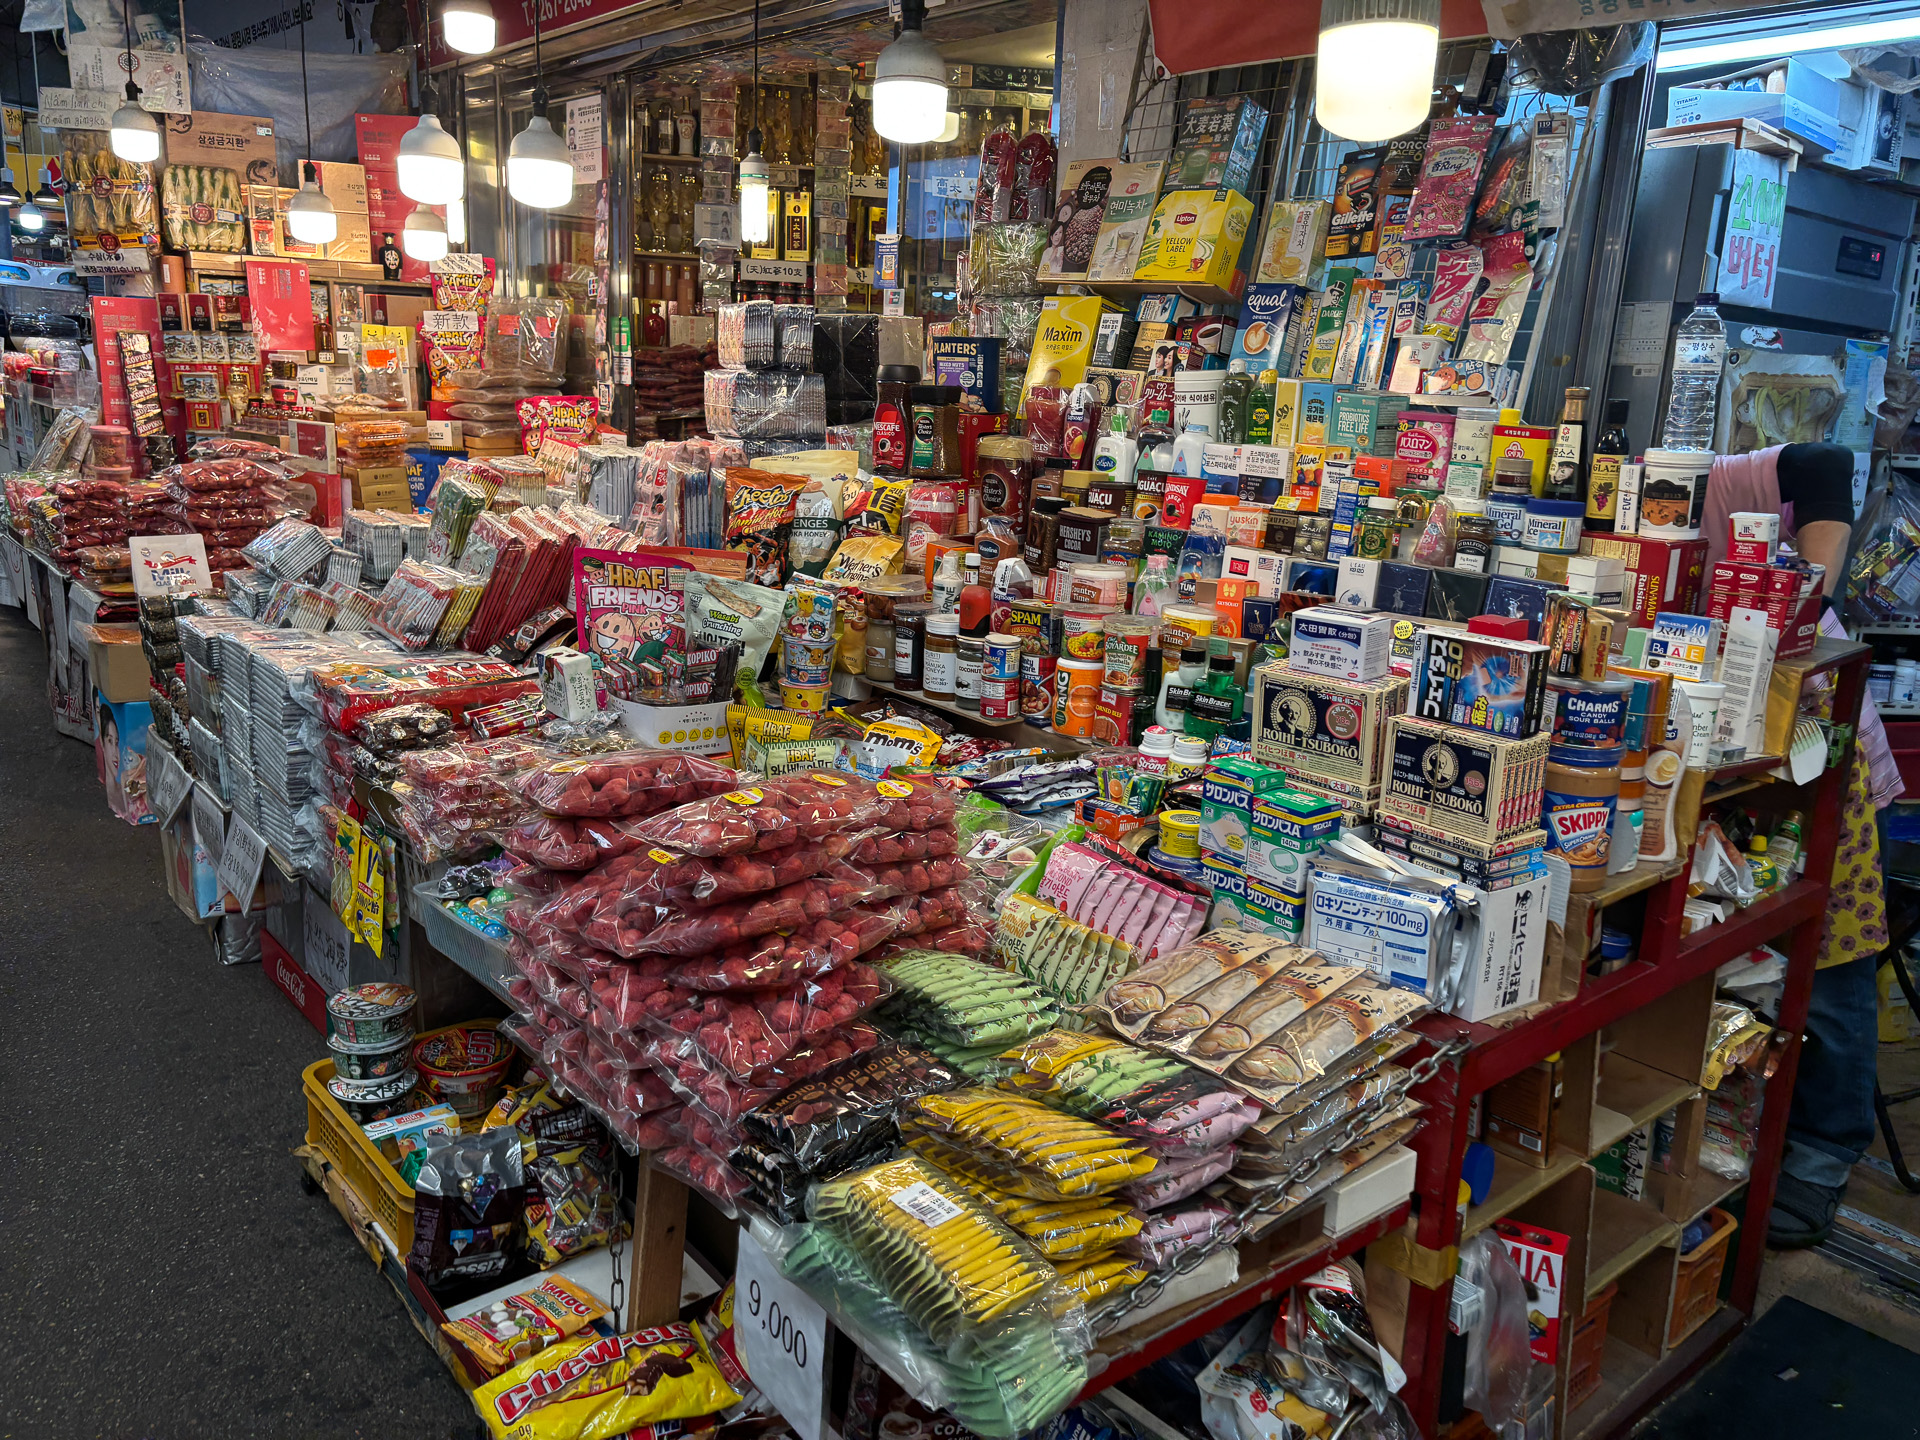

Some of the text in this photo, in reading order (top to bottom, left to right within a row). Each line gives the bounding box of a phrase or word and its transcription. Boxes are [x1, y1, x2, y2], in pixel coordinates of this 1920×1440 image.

[1676, 96, 1699, 106] TITANIA
[1184, 113, 1236, 135] 大麦若葉
[1434, 121, 1446, 131] 30
[1413, 150, 1423, 161] 6
[1109, 201, 1145, 216] 현미녹차
[1176, 214, 1195, 223] Lipton
[1332, 211, 1374, 226] Gillette
[1166, 237, 1193, 246] YELLOW
[1166, 245, 1187, 253] LABEL
[1247, 292, 1286, 308] equal
[433, 313, 469, 329] 新款
[1042, 325, 1083, 342] Maxim
[433, 336, 471, 348] FAMILY
[933, 342, 977, 355] PLANTERS
[130, 386, 156, 400] KOPIKO
[1189, 393, 1216, 403] 식이섬유
[552, 407, 581, 420] HBAF
[1338, 411, 1370, 423] PROBIOTICS
[548, 416, 586, 428] FAMILY
[1337, 421, 1369, 434] FREE LIFE
[1397, 422, 1409, 432] 30
[1399, 436, 1433, 450] バスロマン
[1296, 453, 1322, 466] Alive!
[1592, 464, 1621, 473] GLAZE
[734, 484, 793, 515] Cheetos
[957, 489, 965, 507] RITZ
[1486, 506, 1522, 521] Mineral
[1229, 515, 1259, 526] yuskin
[1496, 518, 1514, 530] Gel
[1528, 518, 1562, 531] Mineral
[1059, 525, 1092, 542] HERSHEY'S
[1301, 523, 1321, 532] Snail
[1527, 526, 1539, 536] Ice
[979, 545, 998, 555] Vaseline
[1064, 540, 1081, 551] COCOA
[151, 567, 191, 582] Milk
[607, 563, 665, 589] HBAF
[1180, 583, 1196, 592] TUM
[1635, 573, 1648, 611] Raisins
[591, 586, 679, 612] FRIENDS
[1073, 594, 1090, 604] Time
[622, 602, 647, 615] PINK
[709, 610, 741, 623] Wasabi
[1011, 610, 1042, 626] SPAM
[702, 618, 742, 636] Crunching
[1298, 623, 1337, 637] 太田胃散
[1656, 623, 1706, 638] スマイル 40
[1105, 641, 1139, 654] BOYARDEE
[1671, 647, 1681, 658] A
[687, 650, 718, 666] KOPIKO
[1303, 650, 1325, 660] 飲みすぎ
[1690, 649, 1699, 660] E
[1307, 658, 1342, 670] 胃の不快感に
[1422, 638, 1464, 719] フェイタス 5.0
[1057, 671, 1069, 711] TANG
[1168, 687, 1182, 697] Skin
[1196, 694, 1232, 707] Skin Bracer
[1567, 697, 1619, 713] CHARMS
[1111, 709, 1122, 718] BEEF
[1568, 715, 1591, 724] SOUR
[763, 721, 791, 738] HBAF
[872, 726, 897, 734] peanut
[787, 749, 816, 763] HBAF
[1138, 757, 1167, 772] Strong
[1331, 781, 1349, 793] 大判
[1205, 782, 1251, 811] サロンパス
[1552, 803, 1575, 812] EXTRA
[1118, 821, 1139, 832] MINTIA
[1557, 811, 1608, 836] SKIPPY
[1563, 833, 1596, 850] SUPER CHUNK
[1201, 864, 1248, 898] サロンパス
[1325, 916, 1381, 938] 外用薬 7枚入
[276, 958, 306, 1008] Coca-Cola
[747, 1278, 807, 1369] 9,000
